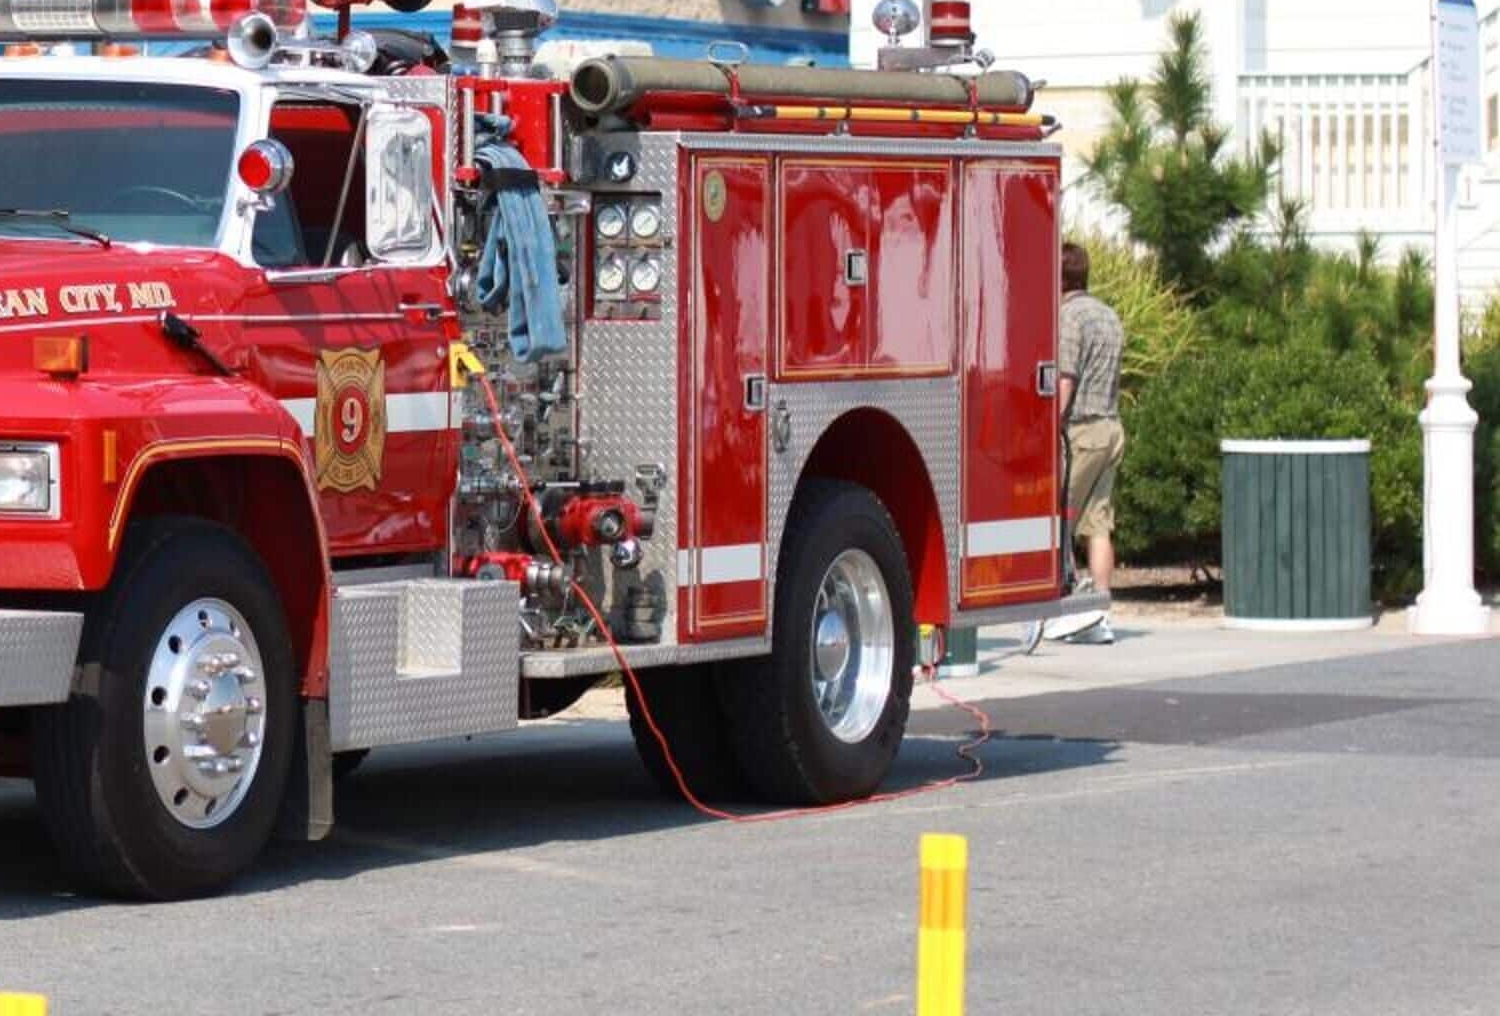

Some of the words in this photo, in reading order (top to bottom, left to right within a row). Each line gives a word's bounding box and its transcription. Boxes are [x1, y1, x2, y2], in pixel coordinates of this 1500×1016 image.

[59, 282, 124, 314] CITY,
[126, 281, 178, 310] MD.
[340, 396, 364, 443] 9
